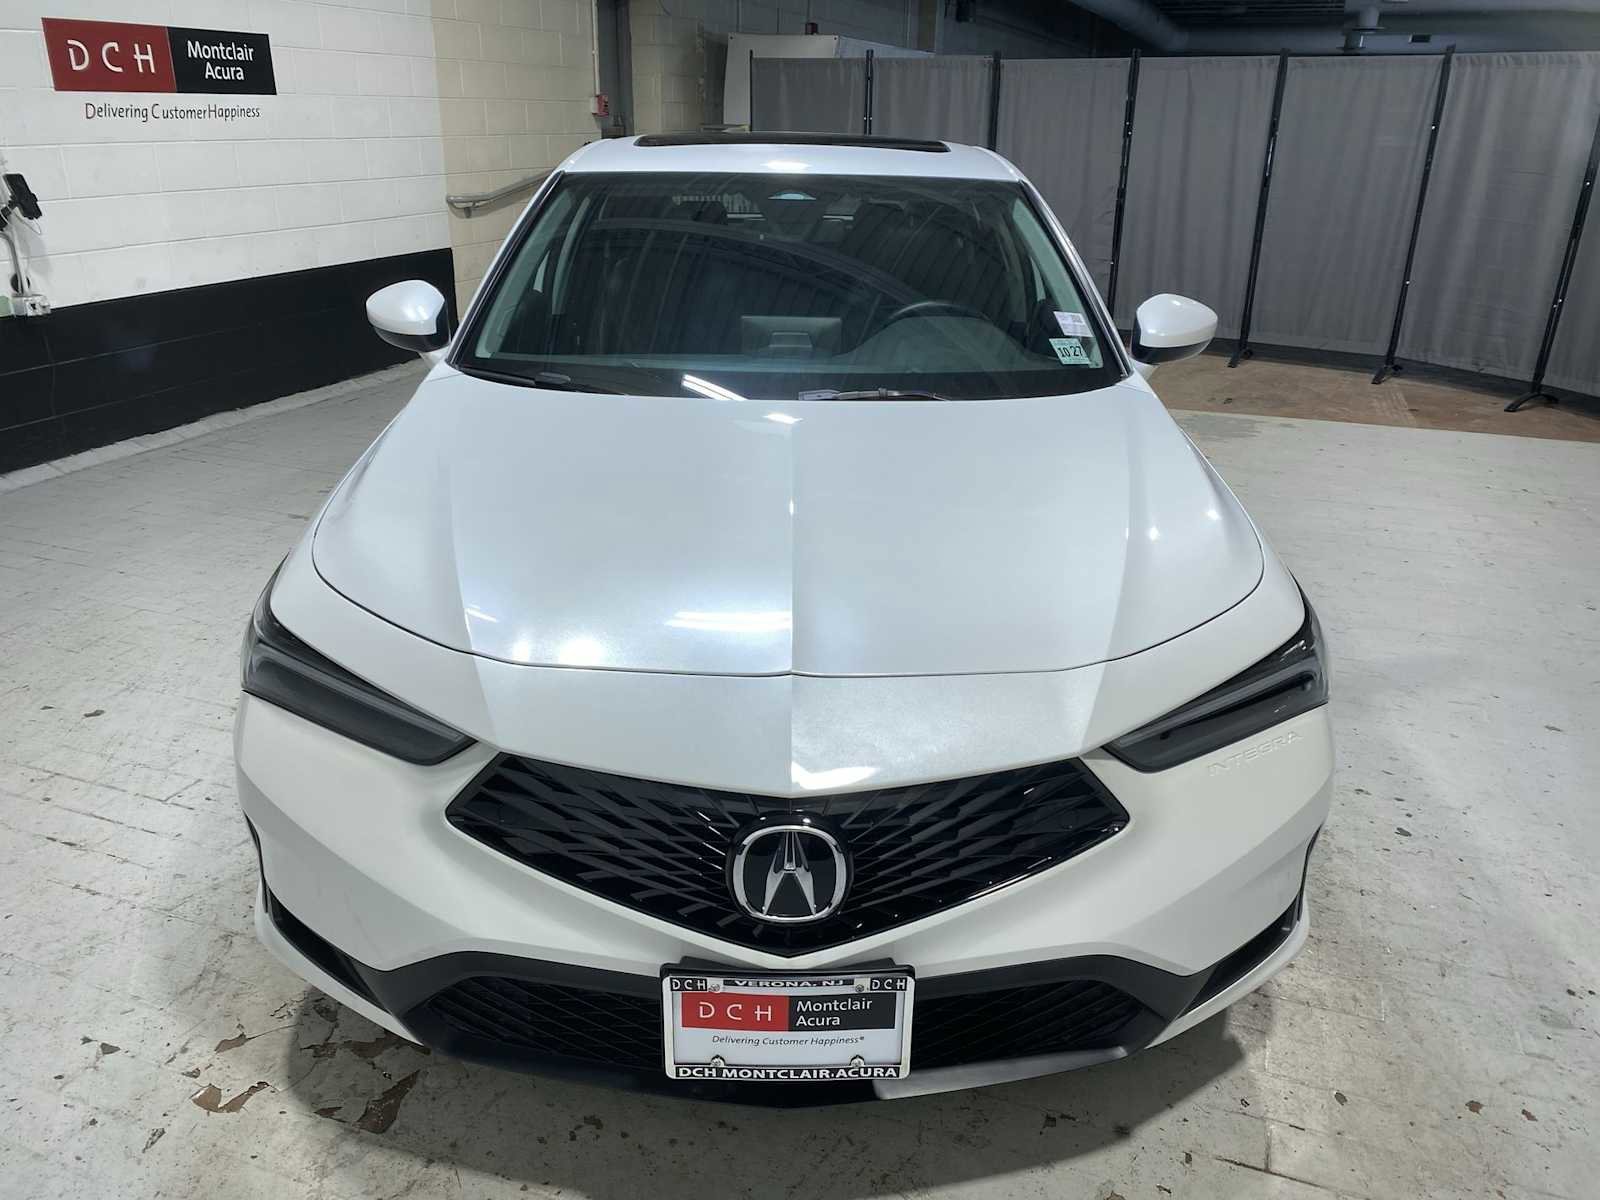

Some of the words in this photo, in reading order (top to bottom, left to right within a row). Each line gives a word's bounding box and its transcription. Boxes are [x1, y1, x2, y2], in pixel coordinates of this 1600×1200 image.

[187, 40, 254, 62] Montclair
[204, 62, 245, 81] Acura
[85, 102, 148, 122] Delivering
[796, 998, 873, 1013] Montclair
[796, 1015, 841, 1027] Acura
[712, 1035, 760, 1047] Delivering
[762, 1036, 808, 1046] Customer
[678, 1067, 718, 1078] DCH
[835, 1066, 897, 1078] ACURA
